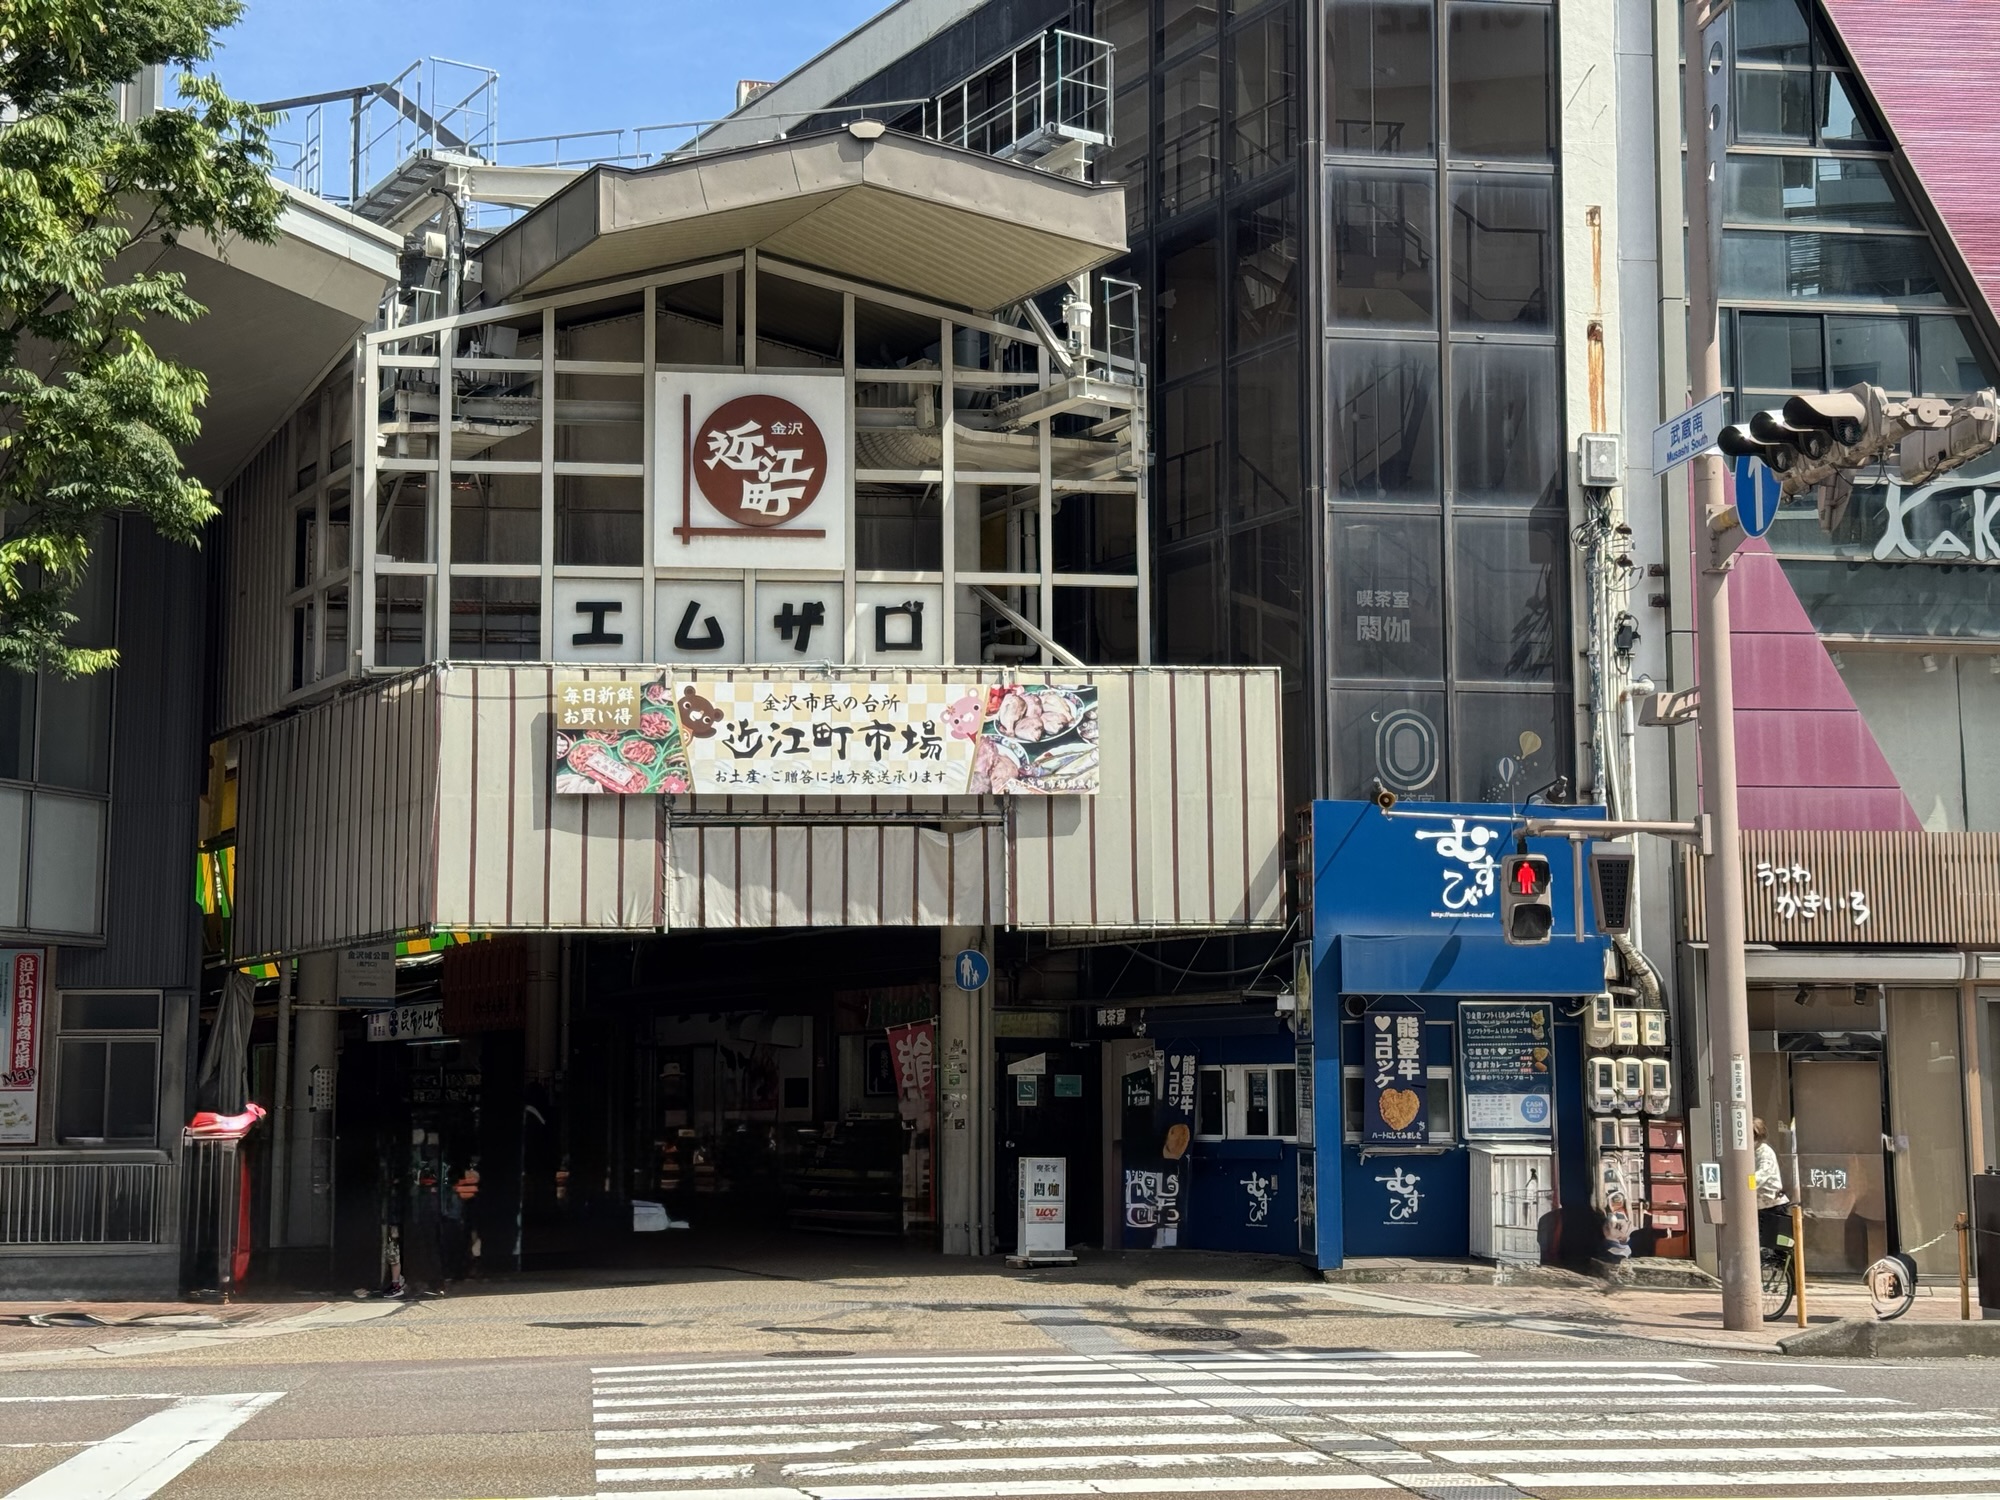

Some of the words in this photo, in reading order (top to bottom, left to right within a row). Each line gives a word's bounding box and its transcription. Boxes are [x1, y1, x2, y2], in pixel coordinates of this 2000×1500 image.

[770, 421, 804, 436] 金沢
[1670, 411, 1703, 447] 武蔵南
[1666, 442, 1689, 464] Musashi
[1691, 432, 1709, 451] South
[703, 420, 815, 517] 近江町
[1356, 590, 1410, 609] 喫茶室
[562, 685, 636, 705] 毎日新鮮
[762, 693, 901, 714] 金沢市民の台所
[563, 707, 633, 726] お買い得
[721, 718, 943, 762] 近江町市場
[1415, 817, 1503, 909] むすび
[1757, 862, 1812, 887] うつわ
[1777, 890, 1871, 926] かきいろ
[15, 956, 35, 1069] 近江町市場商店街
[1374, 1033, 1396, 1088] コロッケ
[1396, 1016, 1421, 1081] 能登牛
[2, 1067, 37, 1086] Map
[1180, 1055, 1196, 1116] 能登牛
[1734, 1063, 1743, 1099] 国土交通省
[1372, 1131, 1422, 1140] ハートにしてみました
[1736, 1111, 1744, 1147] 3007
[1036, 1164, 1058, 1173] 喫茶室
[1240, 1171, 1272, 1222] むすび
[1374, 1167, 1425, 1220] むすび
[1035, 1208, 1058, 1217] UCC
